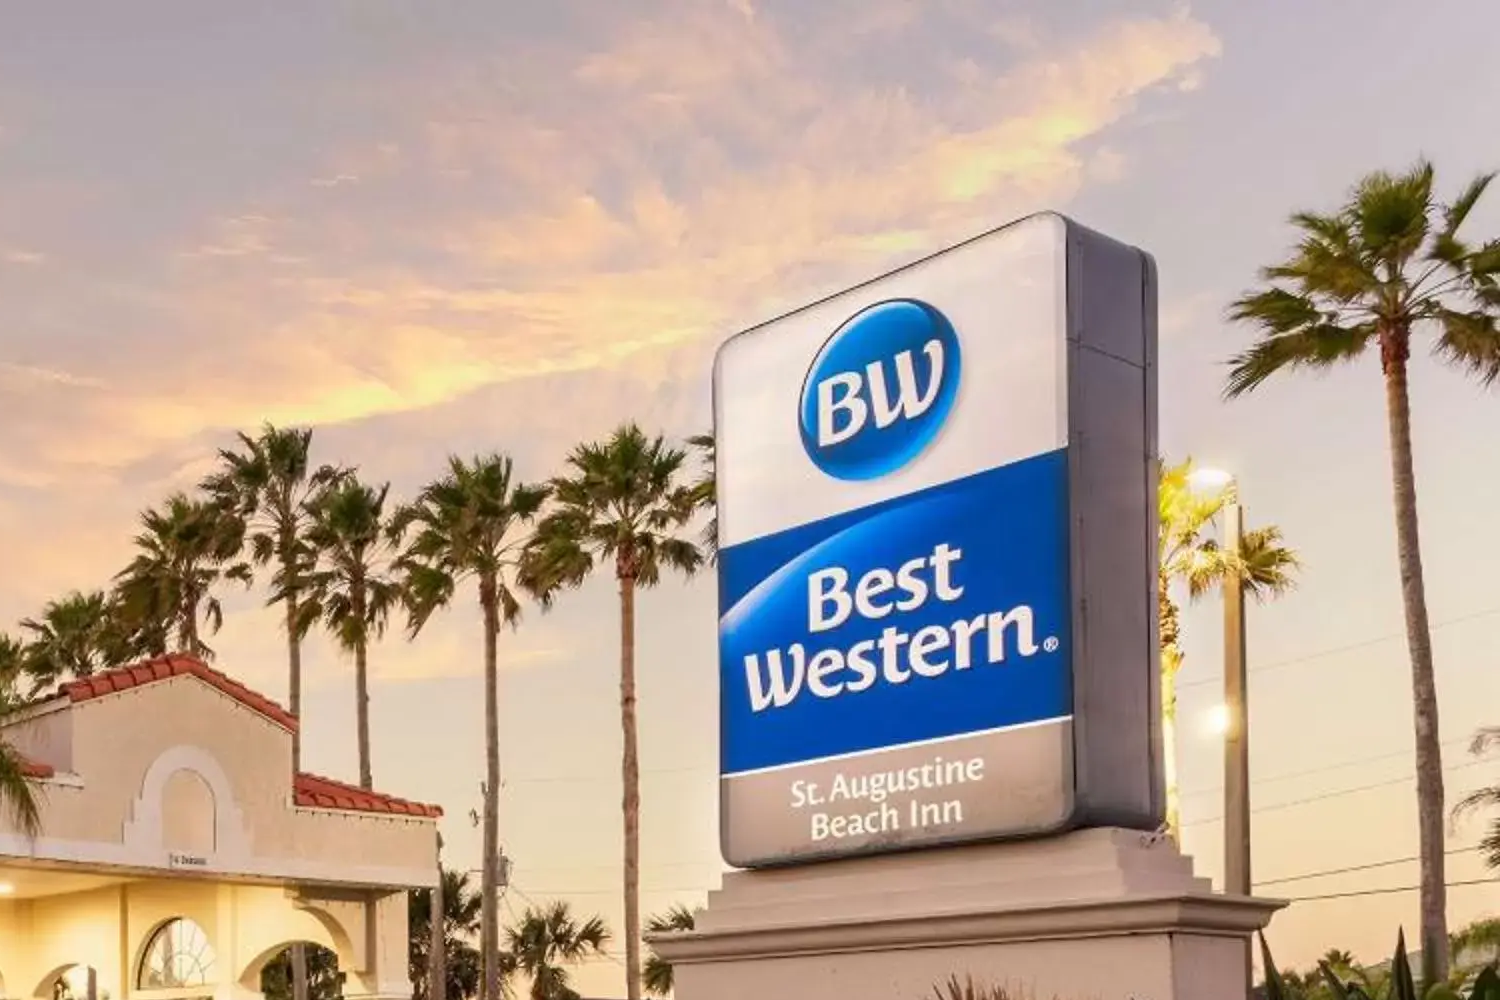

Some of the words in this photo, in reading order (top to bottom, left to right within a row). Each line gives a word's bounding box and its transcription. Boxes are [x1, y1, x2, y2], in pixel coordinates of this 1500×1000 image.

[815, 338, 945, 448] BW
[807, 542, 964, 633] Best
[789, 780, 825, 808] St.
[829, 756, 985, 802] Augustine
[810, 802, 900, 841] Beach
[910, 799, 963, 828] Inn
